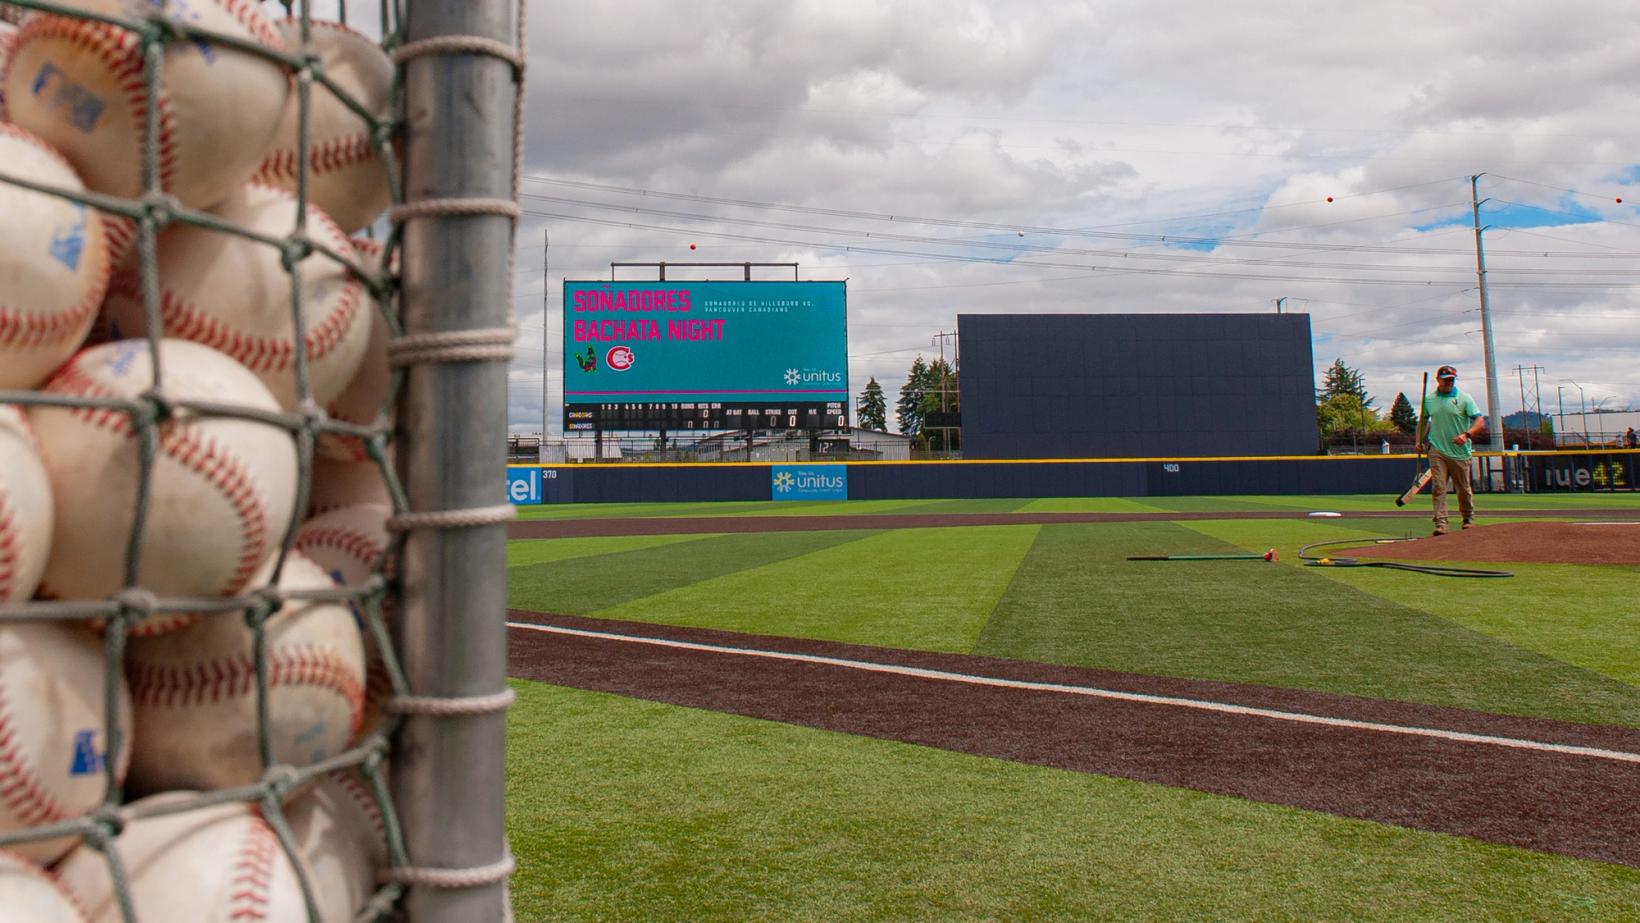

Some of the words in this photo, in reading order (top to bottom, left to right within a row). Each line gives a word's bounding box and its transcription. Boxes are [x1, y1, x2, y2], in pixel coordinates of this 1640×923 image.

[574, 284, 691, 313] SOÑADORES
[574, 319, 661, 342] BACHATA
[667, 319, 726, 342] NIGHT
[802, 370, 842, 382] unitus
[703, 409, 709, 418] 0
[789, 415, 796, 427] 0
[837, 415, 845, 427] 0
[1163, 463, 1180, 473] 400
[542, 470, 557, 479] 370
[797, 474, 844, 488] unitus
